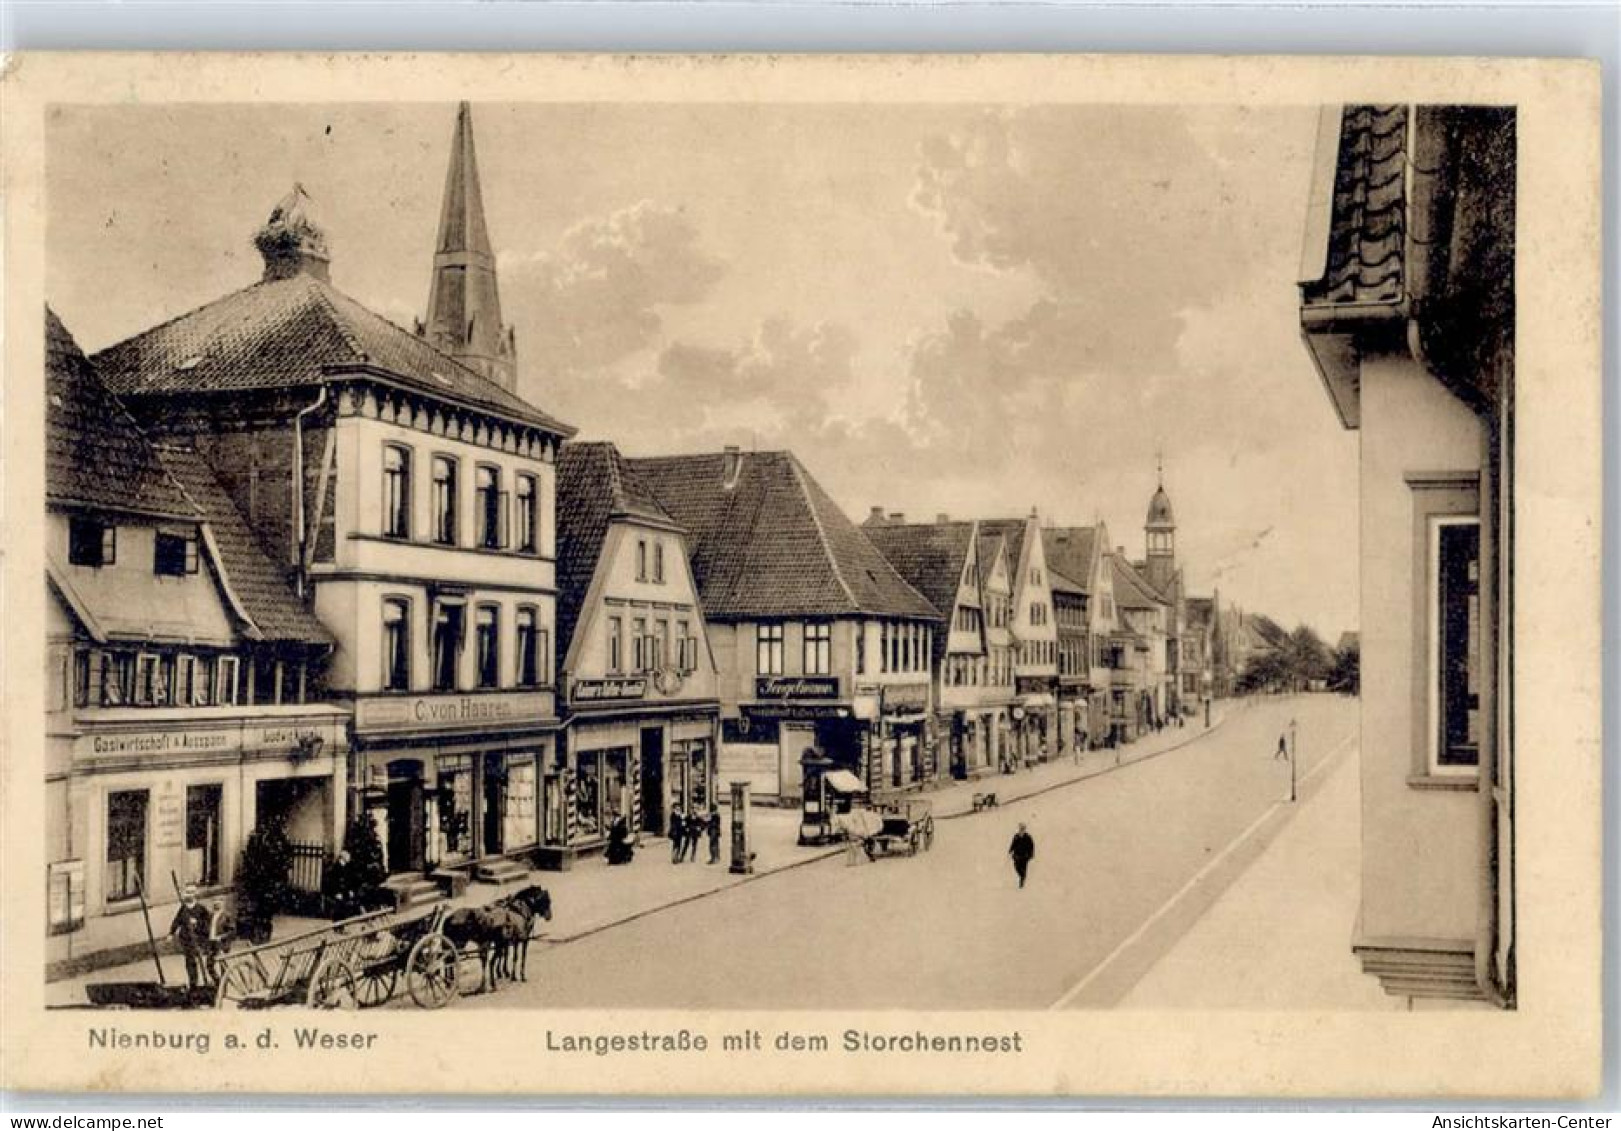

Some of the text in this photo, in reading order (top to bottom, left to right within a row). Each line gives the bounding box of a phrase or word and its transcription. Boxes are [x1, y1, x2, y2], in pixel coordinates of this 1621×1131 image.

[430, 703, 457, 719] von
[88, 1027, 378, 1055] Nienburg a. d. Weser
[546, 1029, 1022, 1056] Langestraße mit dem Storchennest
